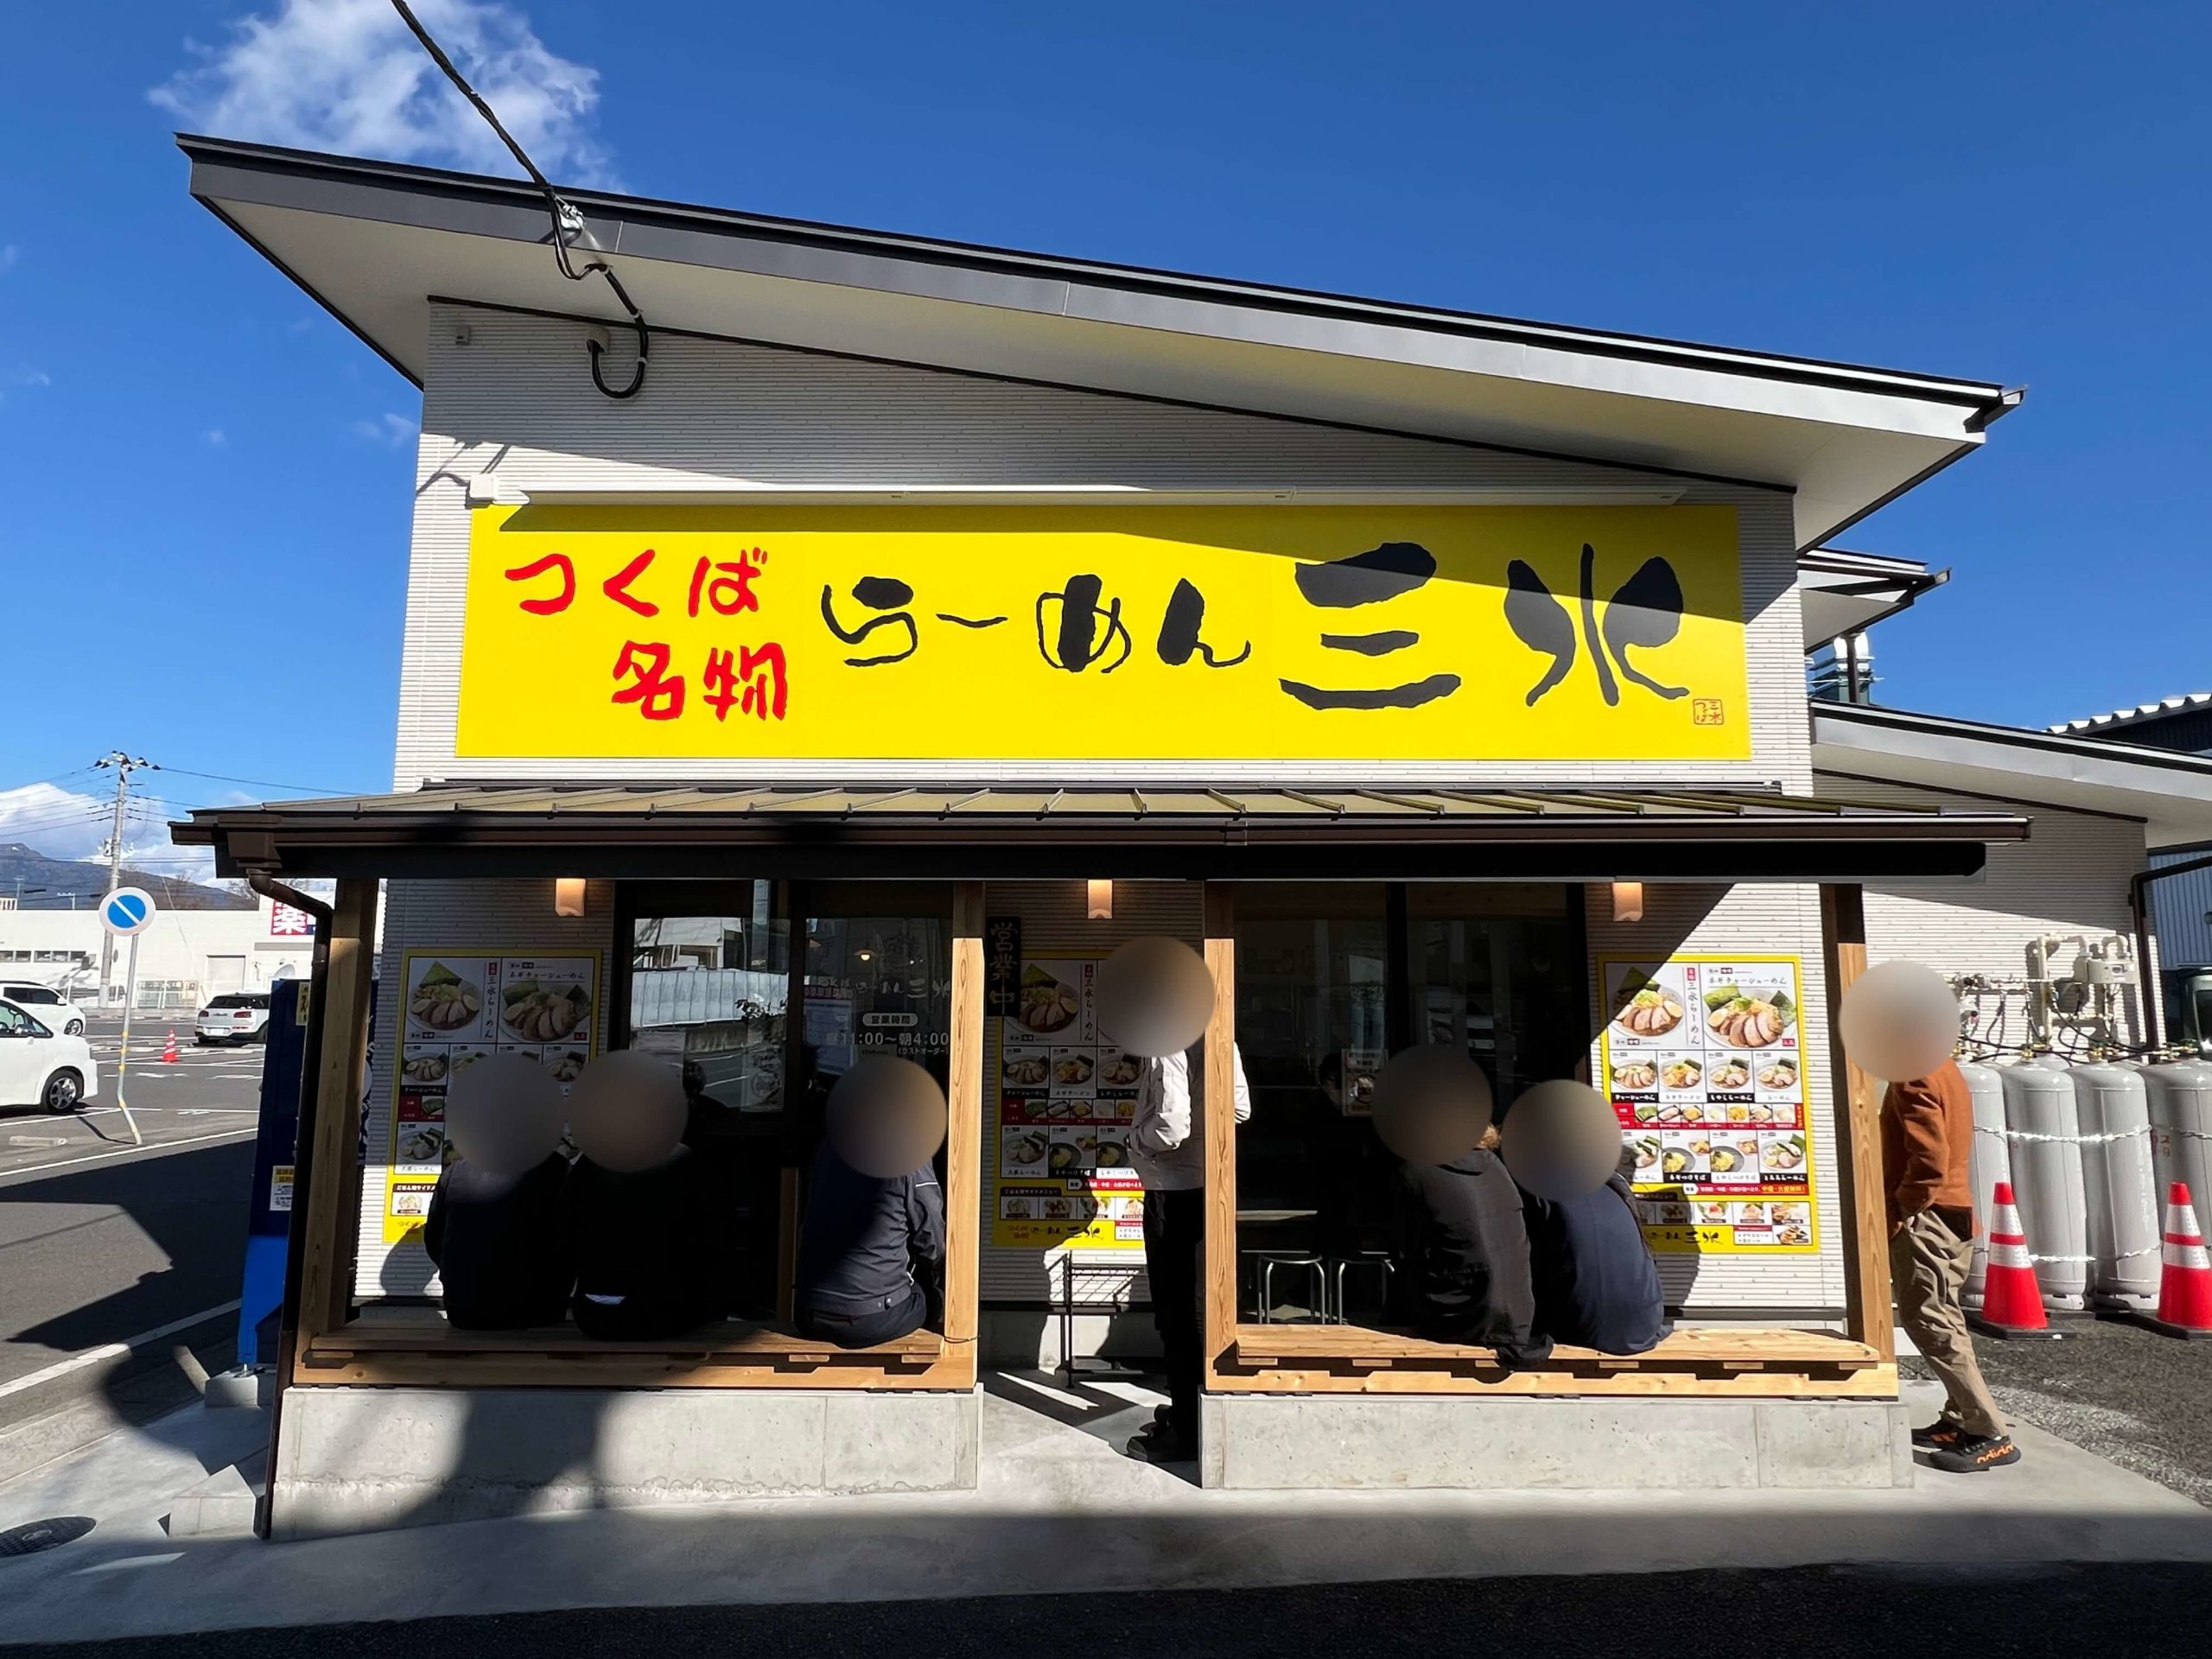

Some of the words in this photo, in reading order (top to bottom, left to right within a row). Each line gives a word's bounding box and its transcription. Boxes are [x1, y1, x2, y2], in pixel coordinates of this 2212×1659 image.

[505, 549, 768, 618] つくば
[612, 640, 788, 721] 名物
[990, 921, 1018, 1014] 営業中
[872, 1015, 911, 1025] 営業時間
